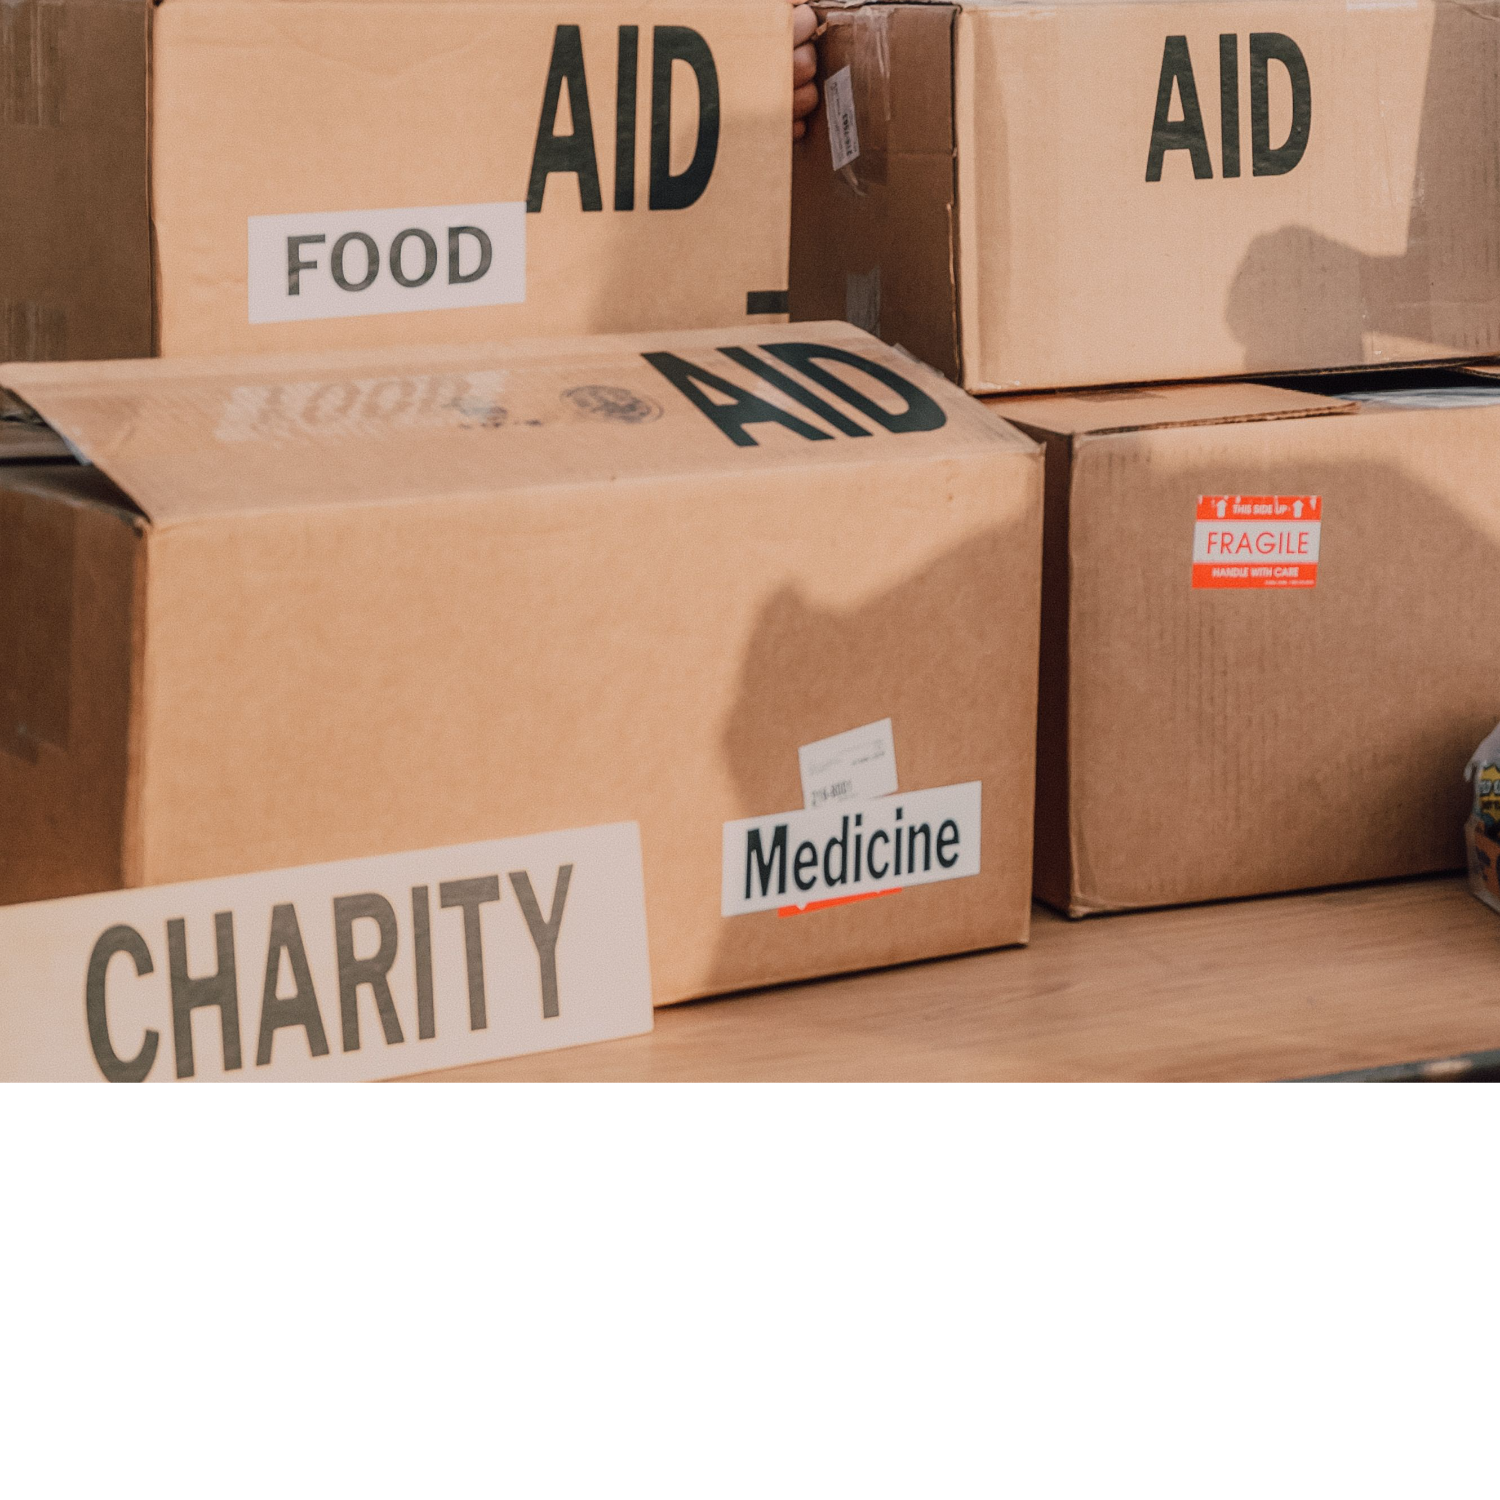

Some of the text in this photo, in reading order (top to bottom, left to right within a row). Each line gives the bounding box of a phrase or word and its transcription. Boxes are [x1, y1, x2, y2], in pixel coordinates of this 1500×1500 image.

[526, 24, 720, 213] AID
[1146, 32, 1312, 183] AID
[288, 226, 493, 296] FOOD
[640, 342, 947, 447] AID
[1207, 531, 1310, 555] FRAGILE
[744, 807, 960, 900] Medicine
[86, 864, 573, 1083] CHARITY
